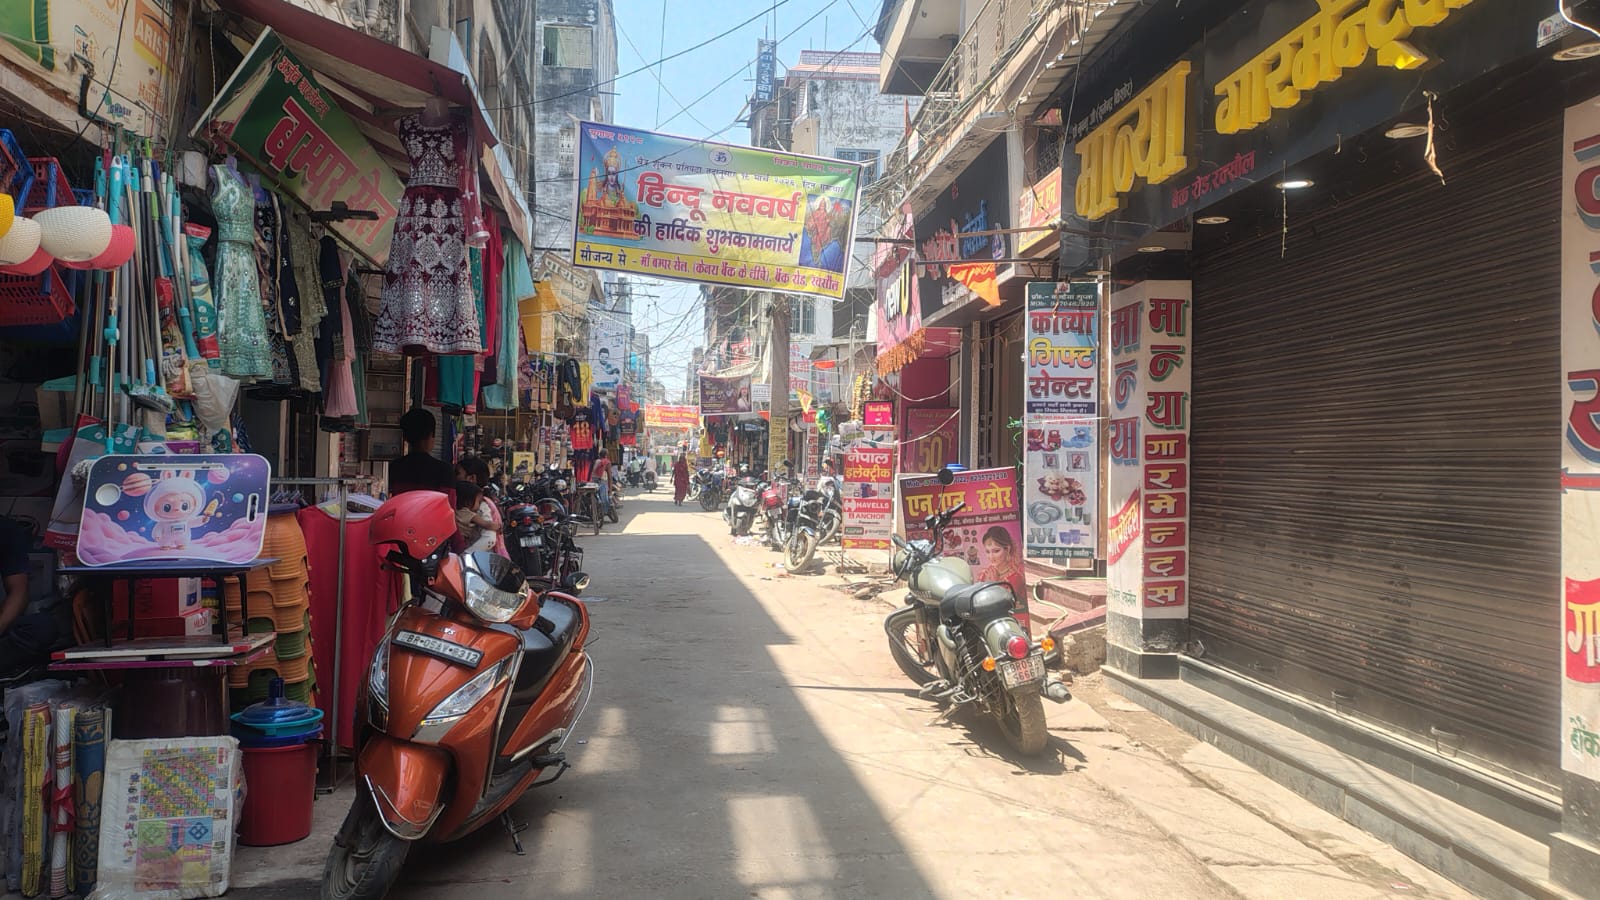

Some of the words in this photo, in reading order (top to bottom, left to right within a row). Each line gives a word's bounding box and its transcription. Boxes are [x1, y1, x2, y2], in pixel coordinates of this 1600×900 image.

[265, 96, 361, 211] बम्पर
[1075, 60, 1192, 221] मान्या
[636, 171, 706, 221] हिन्दू
[711, 190, 803, 222] नववर्ष
[633, 217, 651, 239] की
[655, 219, 703, 243] हार्दिक
[705, 228, 798, 254] शुभकामनायें
[580, 249, 613, 264] सौजन्य
[617, 250, 627, 266] से
[651, 255, 672, 271] बम्पर
[1029, 311, 1095, 336] काव्या
[1028, 337, 1095, 369] गिफ्ट
[1028, 369, 1095, 399] सेन्टर
[847, 449, 889, 465] नेपाल
[976, 482, 1013, 512] स्टोर
[856, 512, 886, 520] ANCHOR
